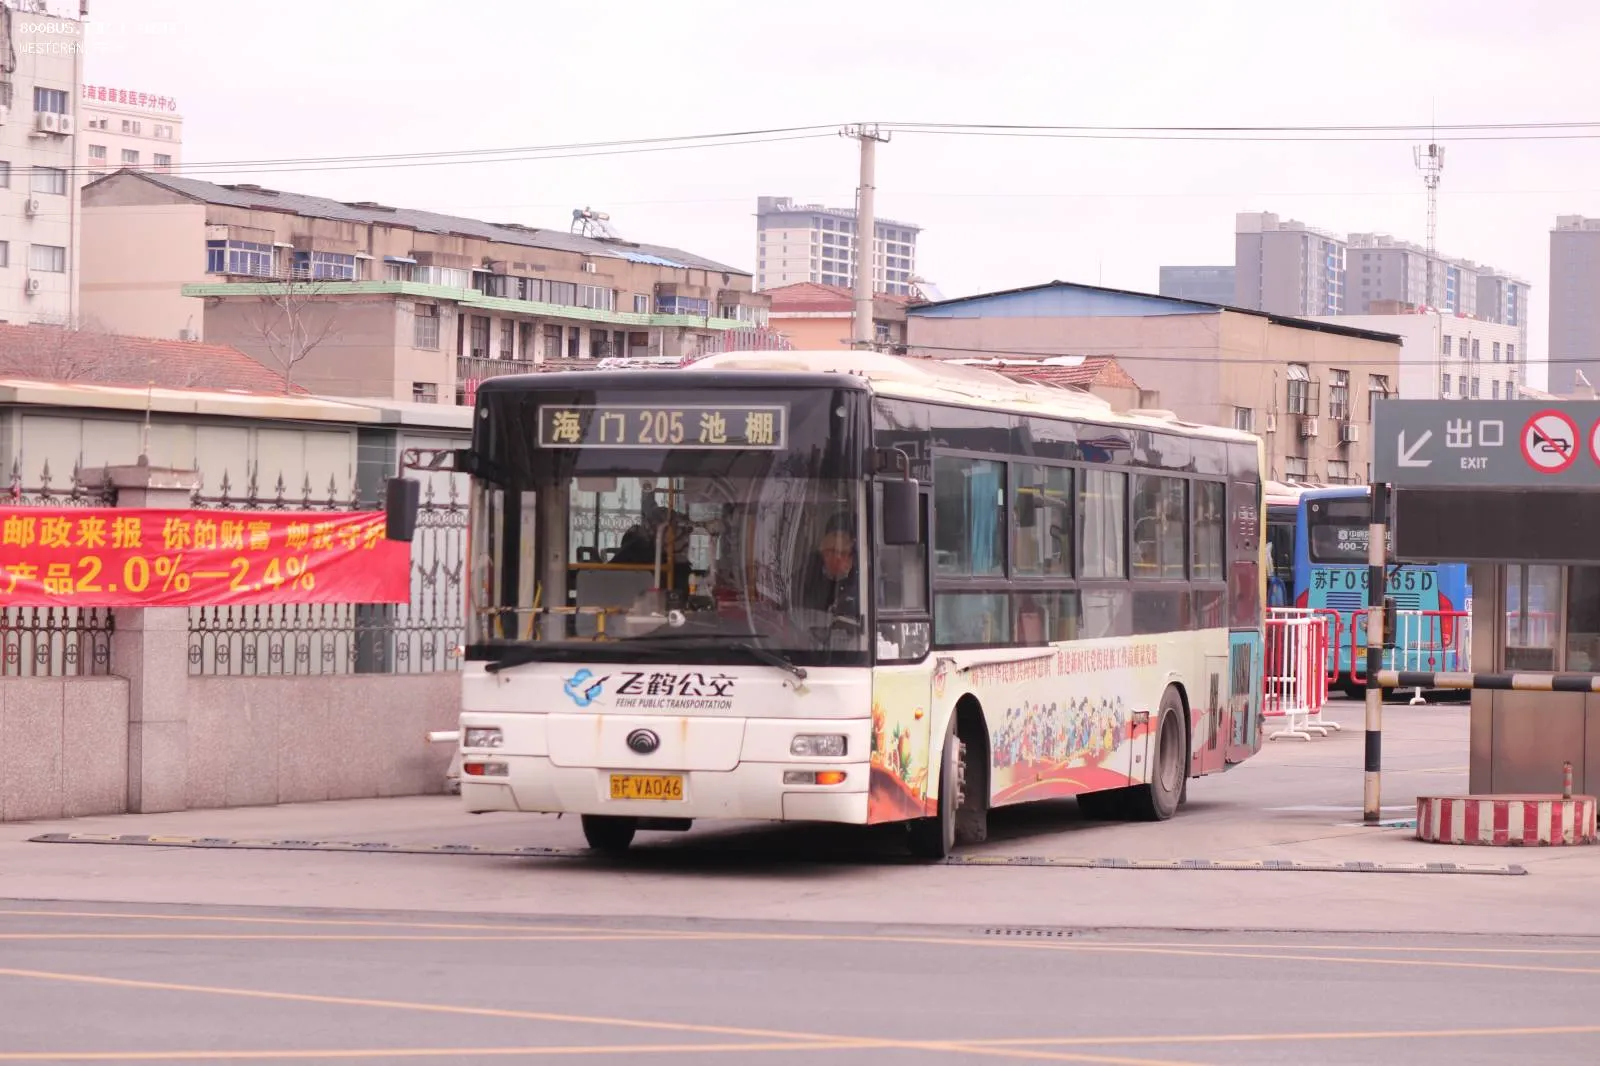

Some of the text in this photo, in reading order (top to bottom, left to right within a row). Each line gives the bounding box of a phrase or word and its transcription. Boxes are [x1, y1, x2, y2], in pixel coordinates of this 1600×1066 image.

[639, 411, 684, 443] 205
[1446, 418, 1504, 448] 出口
[1460, 456, 1489, 469] EXIT
[162, 518, 271, 551] 你的财富
[1315, 570, 1433, 591] 苏F0965D
[615, 672, 739, 697] 飞鹤公交
[615, 699, 732, 709] FEIHE PUBLIC TRANSPORTATION
